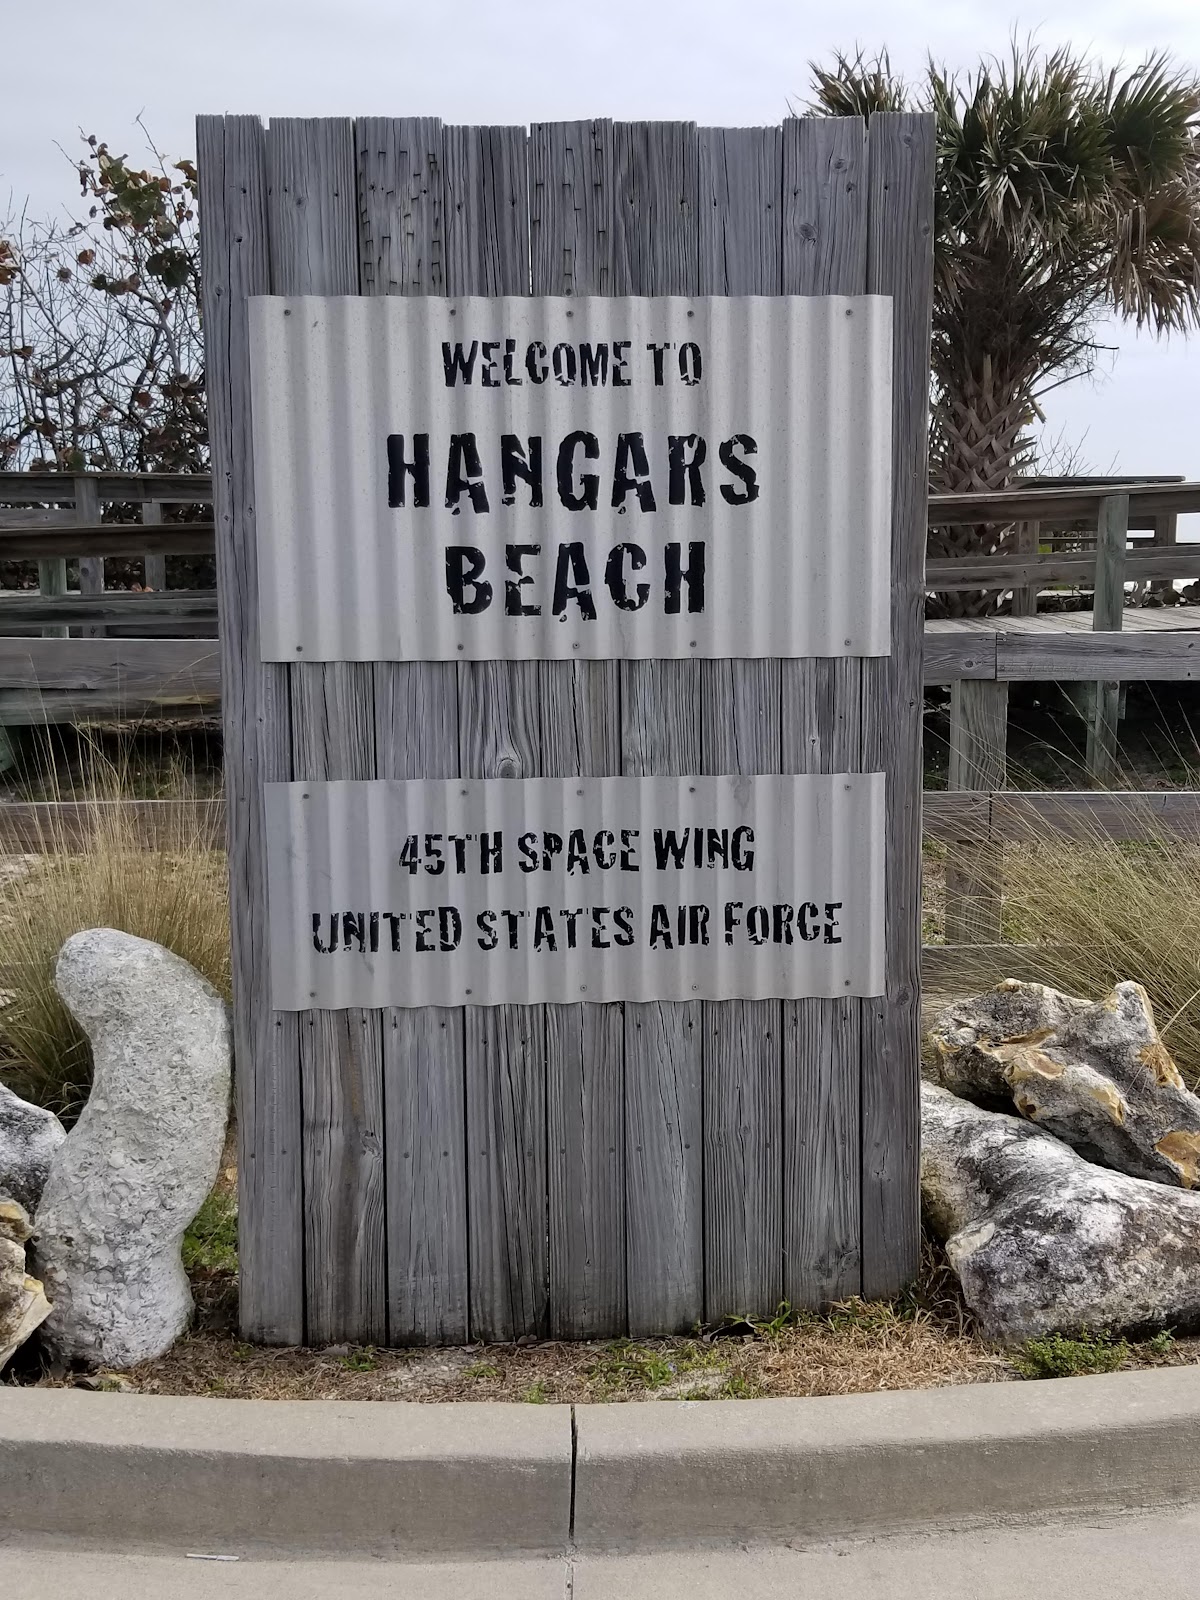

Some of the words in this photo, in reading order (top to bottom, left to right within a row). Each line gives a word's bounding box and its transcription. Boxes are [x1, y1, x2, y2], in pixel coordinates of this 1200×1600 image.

[442, 338, 632, 388] WELCOME
[646, 341, 703, 388] TO
[386, 430, 761, 516] HANGARS
[445, 540, 706, 623] BEACH
[398, 830, 503, 877] 45TH
[517, 828, 640, 876] SPACE
[653, 825, 756, 872] WING
[311, 906, 462, 955] UNITED
[476, 905, 635, 952] STATES
[649, 903, 710, 949] AIR
[724, 901, 843, 948] FORCE
